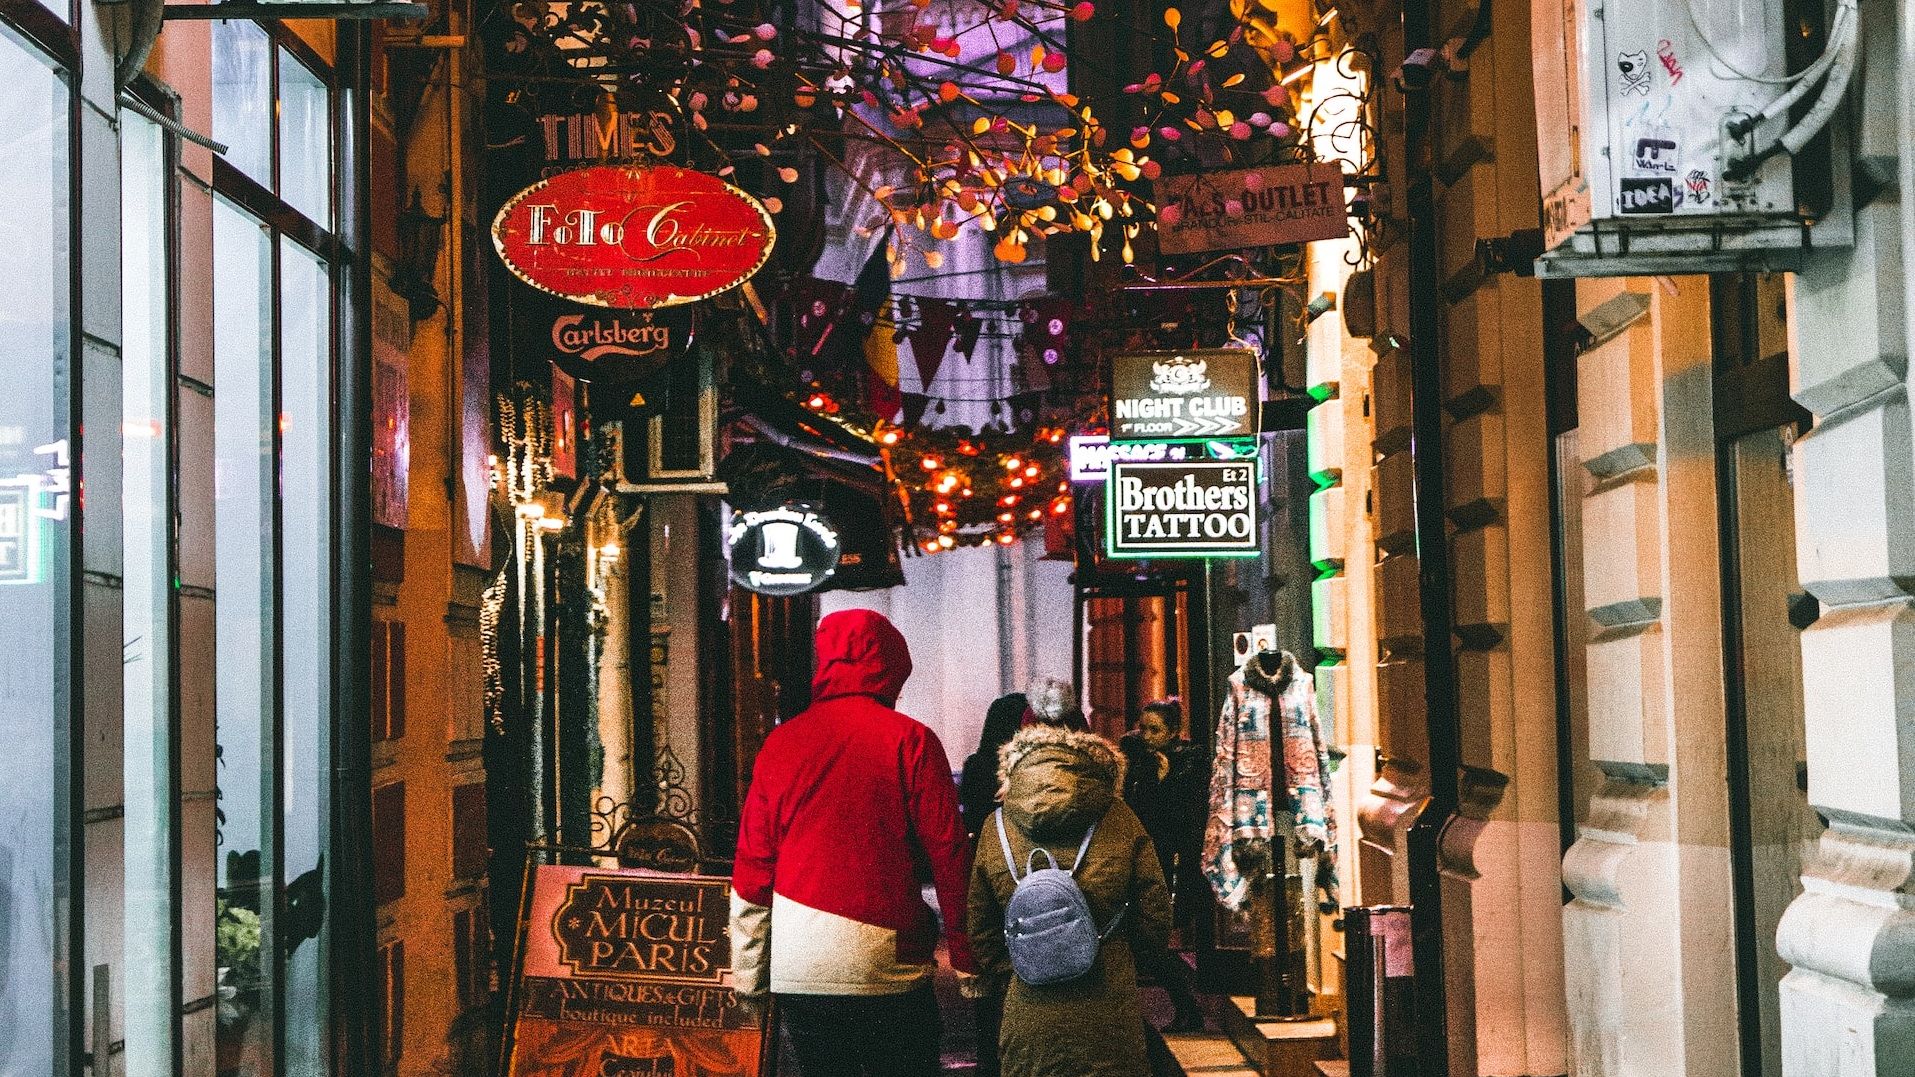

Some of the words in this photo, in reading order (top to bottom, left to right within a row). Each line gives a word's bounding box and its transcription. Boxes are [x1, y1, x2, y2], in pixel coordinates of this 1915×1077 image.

[536, 109, 676, 160] TIMES
[1241, 181, 1330, 213] OUTLET
[620, 201, 750, 262] Cabinet
[552, 313, 670, 355] Carlsberg
[1116, 398, 1184, 418] NIGHT
[1188, 396, 1248, 417] CLUB
[1134, 422, 1173, 433] FLOOR
[1239, 469, 1248, 482] 2
[1121, 474, 1248, 511] Brothers
[1124, 513, 1251, 538] TATTOO
[596, 885, 704, 912] Muzeul
[559, 998, 638, 1026] boutique
[648, 1005, 725, 1028] included
